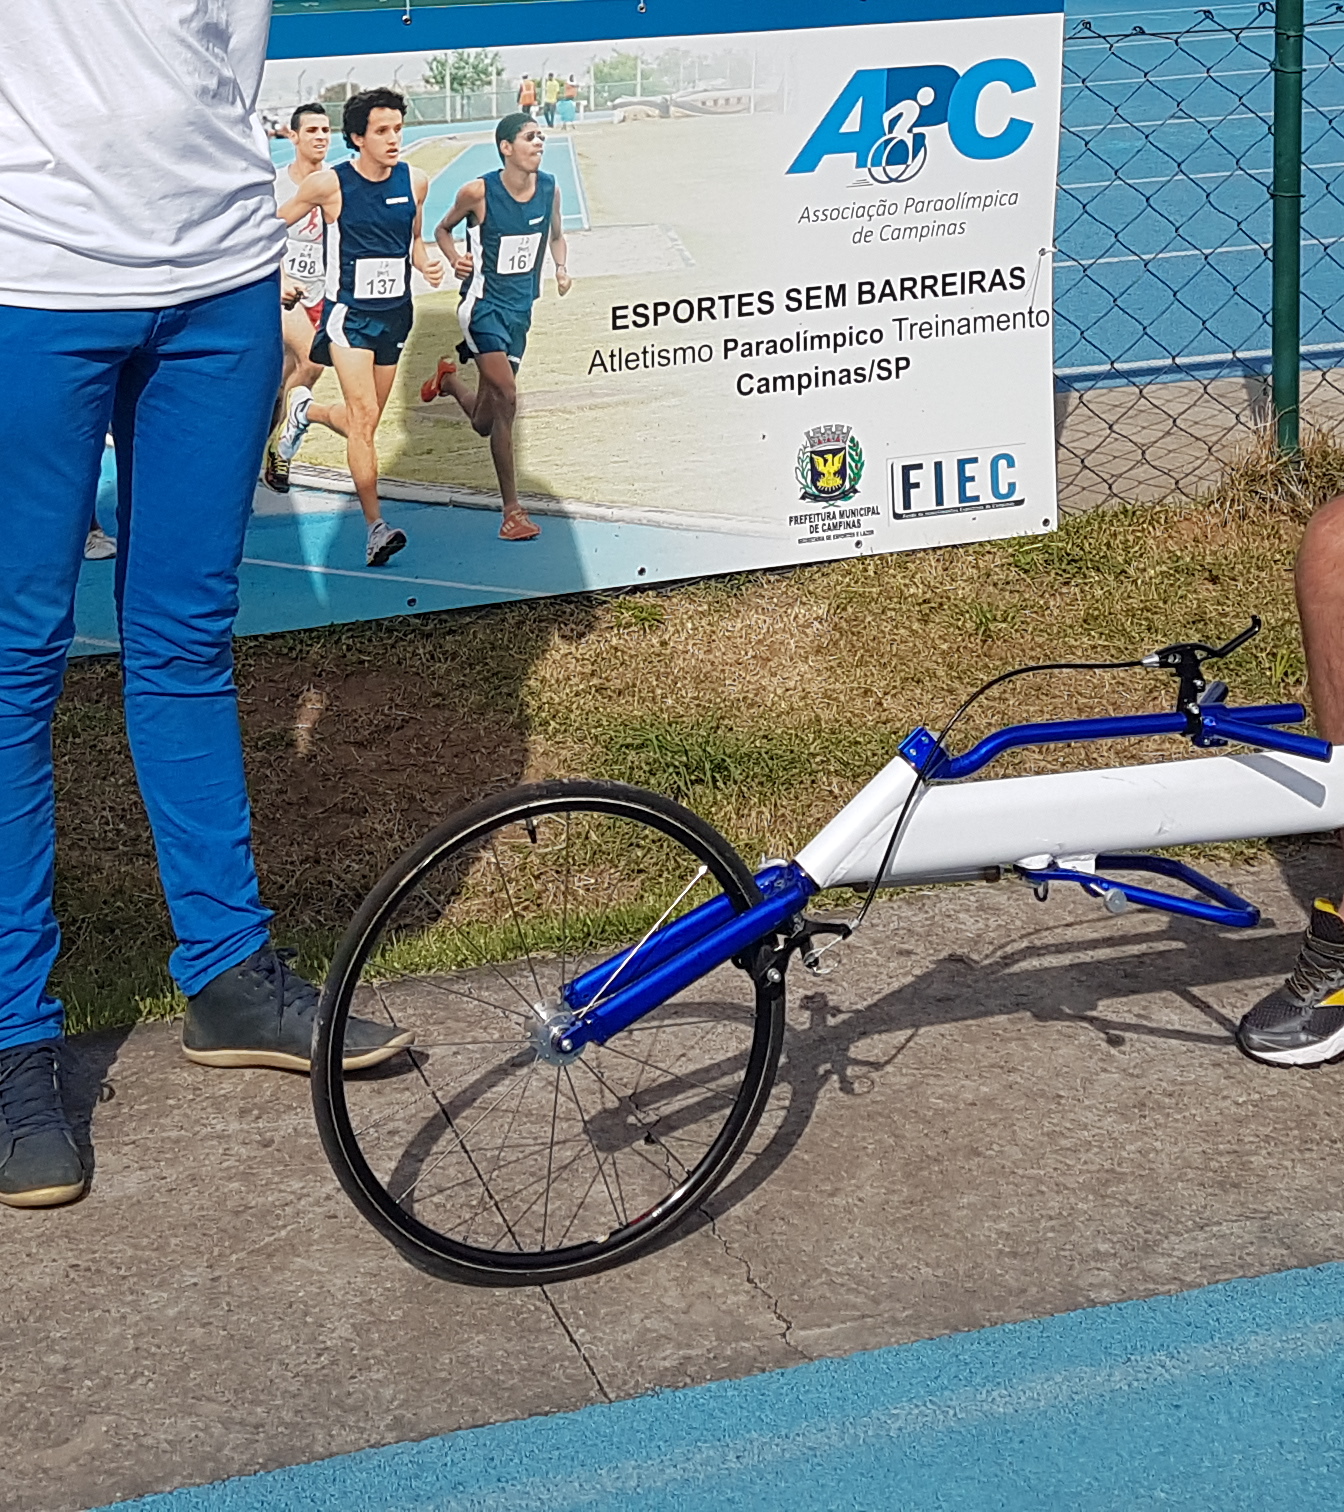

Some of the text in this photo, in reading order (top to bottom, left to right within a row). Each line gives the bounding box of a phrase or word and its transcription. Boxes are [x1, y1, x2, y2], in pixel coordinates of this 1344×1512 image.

[785, 58, 1037, 175] APC
[798, 189, 1019, 224] Associação Paraolímpica
[852, 221, 966, 244] de Campinas
[288, 257, 316, 275] 198
[509, 253, 531, 270] 16
[367, 279, 396, 295] 137
[612, 266, 1026, 330] ESPORTES SEM BARREIRAS
[588, 306, 1050, 375] Atletismo Paraolímpico Treinamento
[736, 357, 911, 396] Campinas/SP
[901, 453, 1016, 510] FIEC
[789, 506, 880, 526] PREFEITURA MUNICIPAL
[809, 519, 861, 534] DE CAMPINAS
